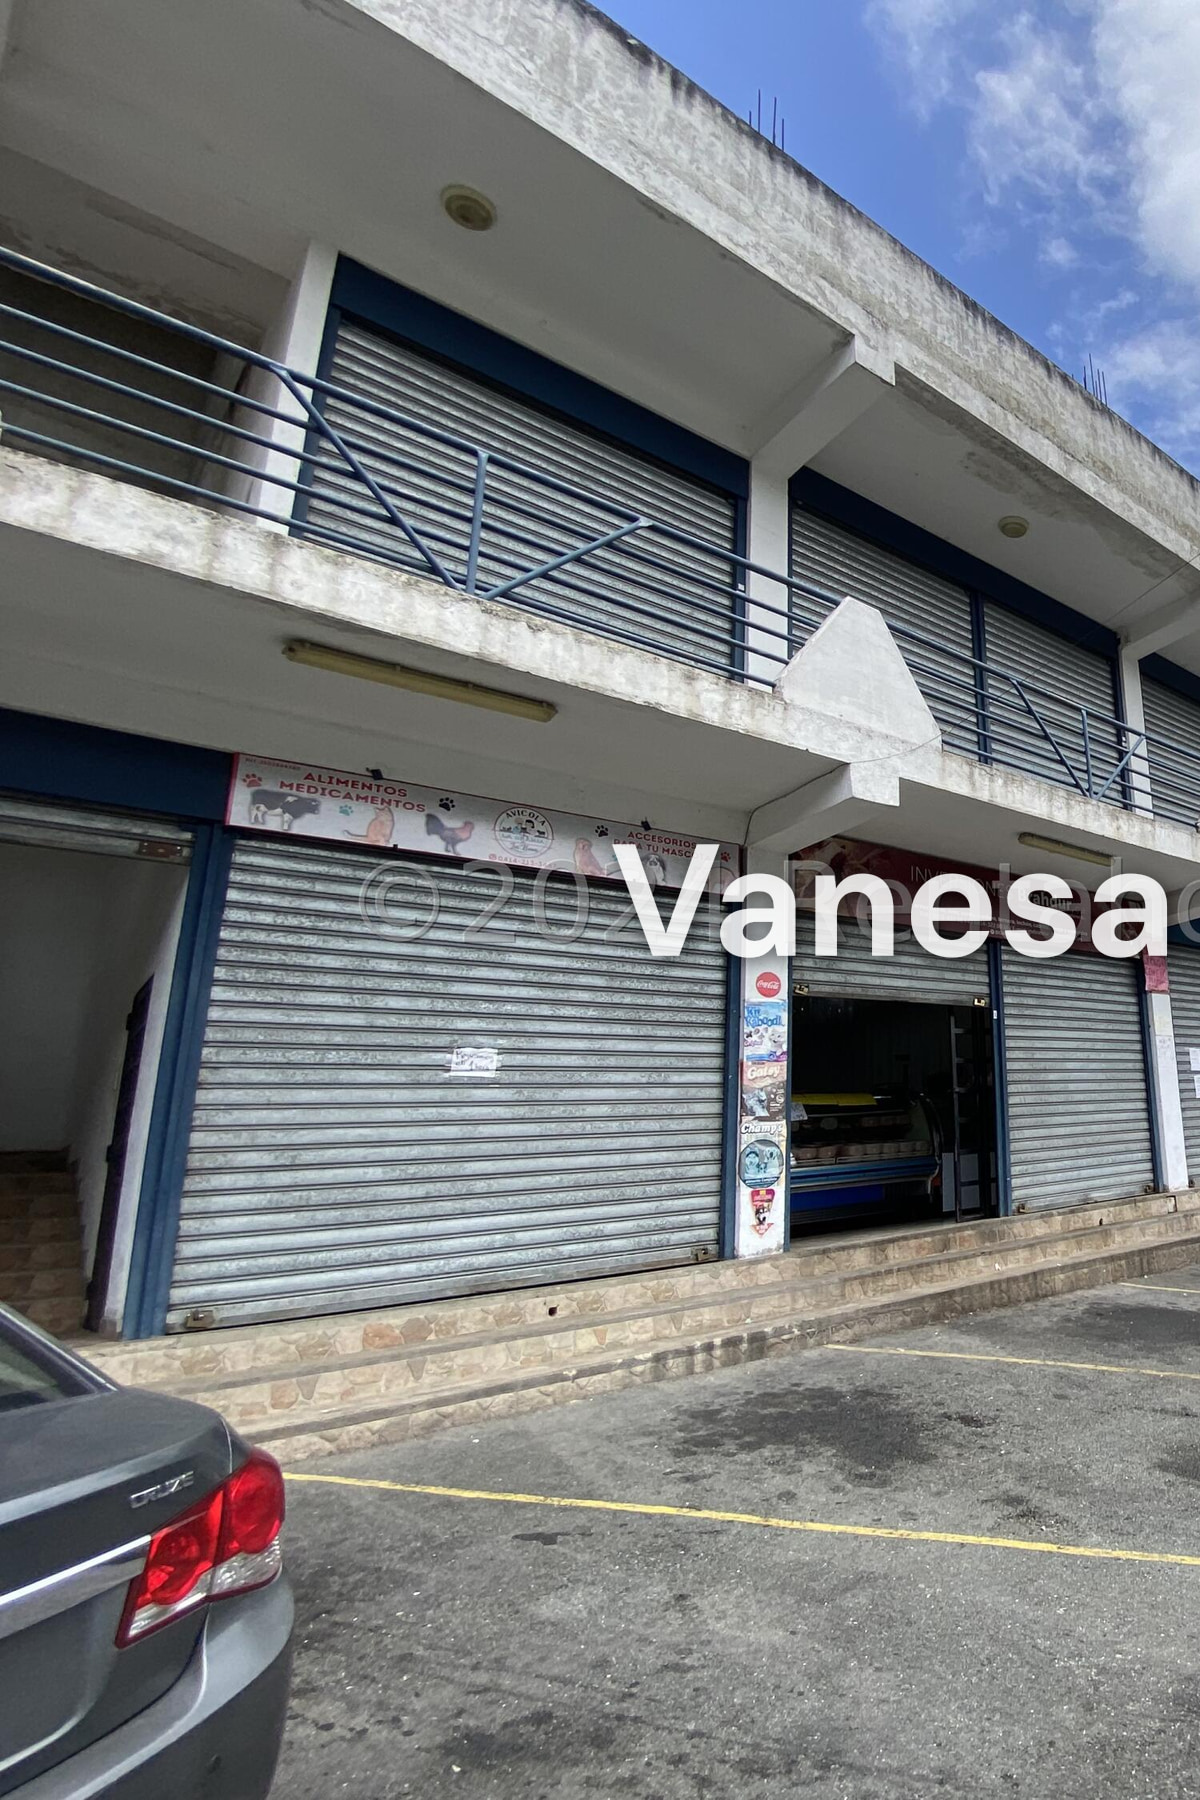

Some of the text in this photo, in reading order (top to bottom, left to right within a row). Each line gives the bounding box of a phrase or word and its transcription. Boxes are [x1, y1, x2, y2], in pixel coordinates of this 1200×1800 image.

[303, 772, 408, 798] ALIMENTOS
[279, 780, 426, 813] MEDICAMENTOS
[506, 809, 546, 826] AVICOLA
[627, 831, 697, 850] ACCESORIOS
[646, 844, 659, 853] TU
[662, 847, 711, 862] MASCO
[744, 1014, 785, 1028] Kaboodl
